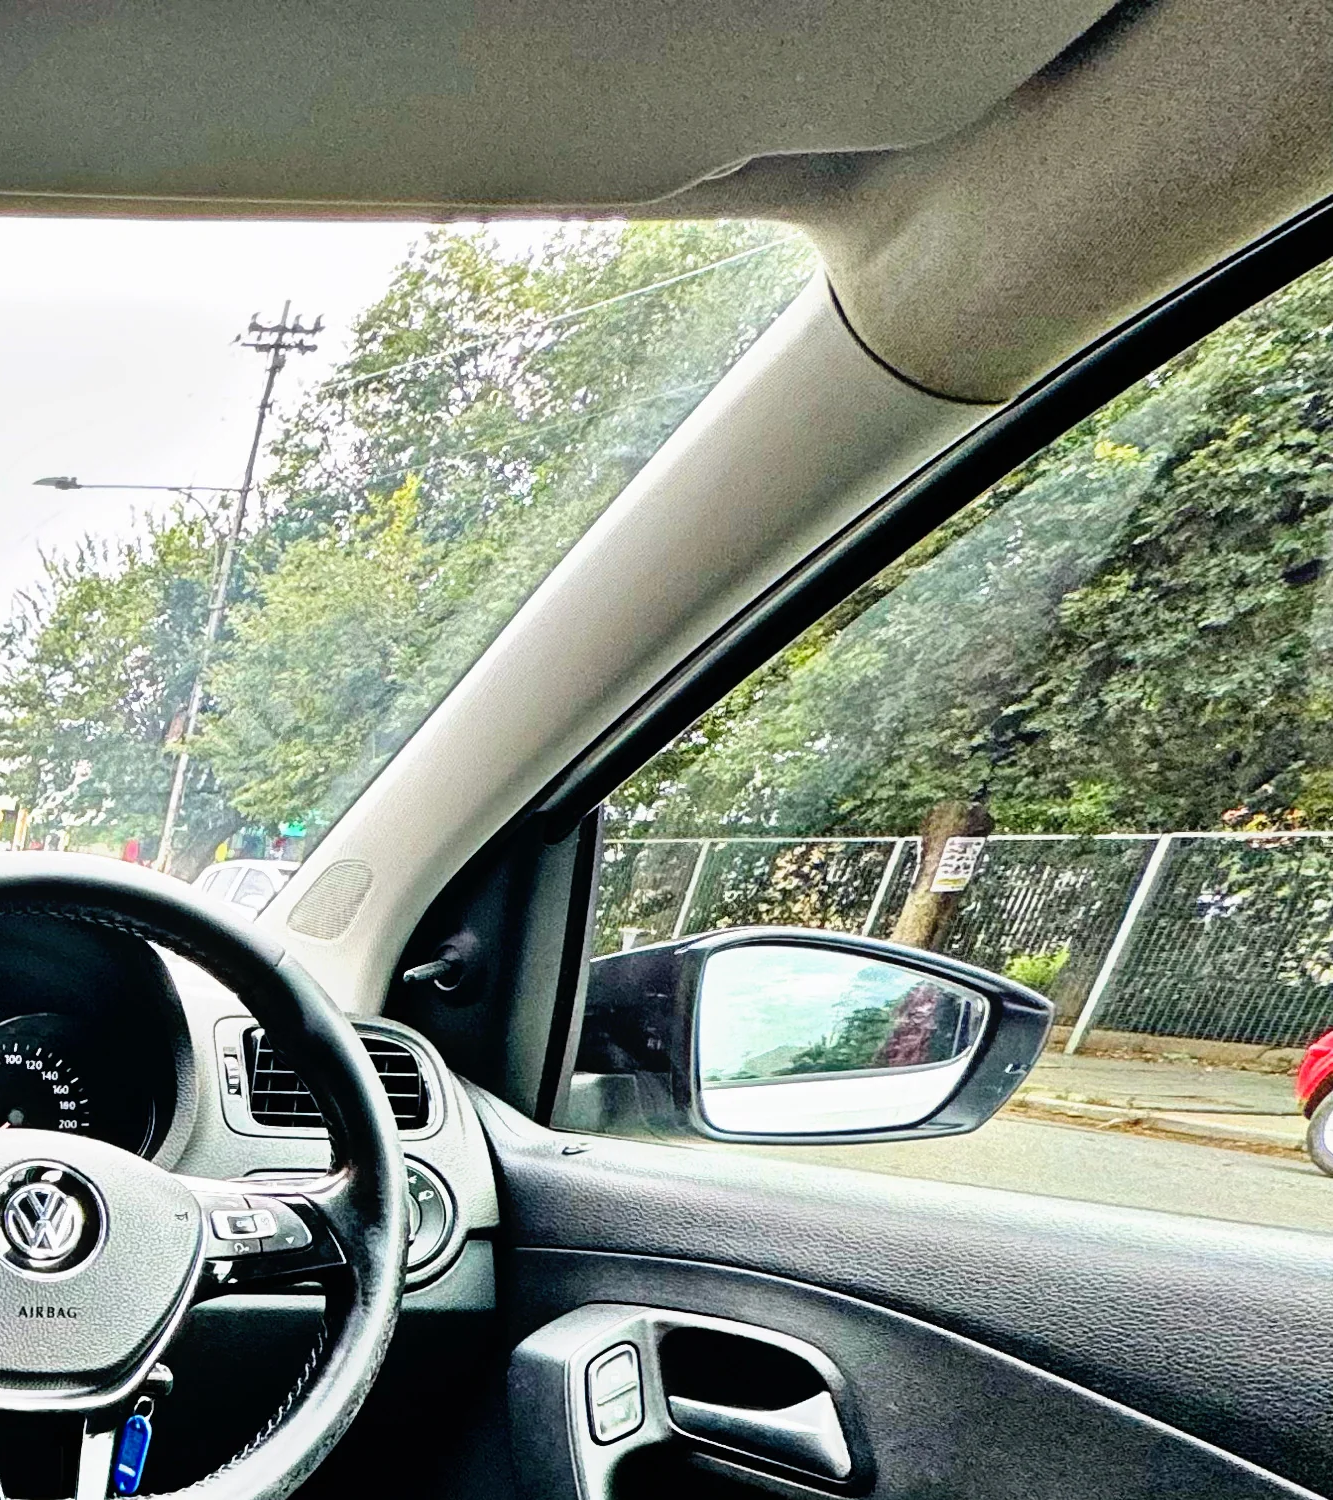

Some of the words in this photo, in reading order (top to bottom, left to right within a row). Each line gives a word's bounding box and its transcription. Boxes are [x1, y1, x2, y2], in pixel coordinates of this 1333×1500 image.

[4, 1054, 23, 1065] 100
[25, 1060, 43, 1070] 120
[41, 1070, 59, 1081] 140
[52, 1084, 70, 1095] 160
[59, 1101, 76, 1111] 180
[58, 1119, 78, 1130] 200
[18, 1306, 78, 1318] AIRBAG
